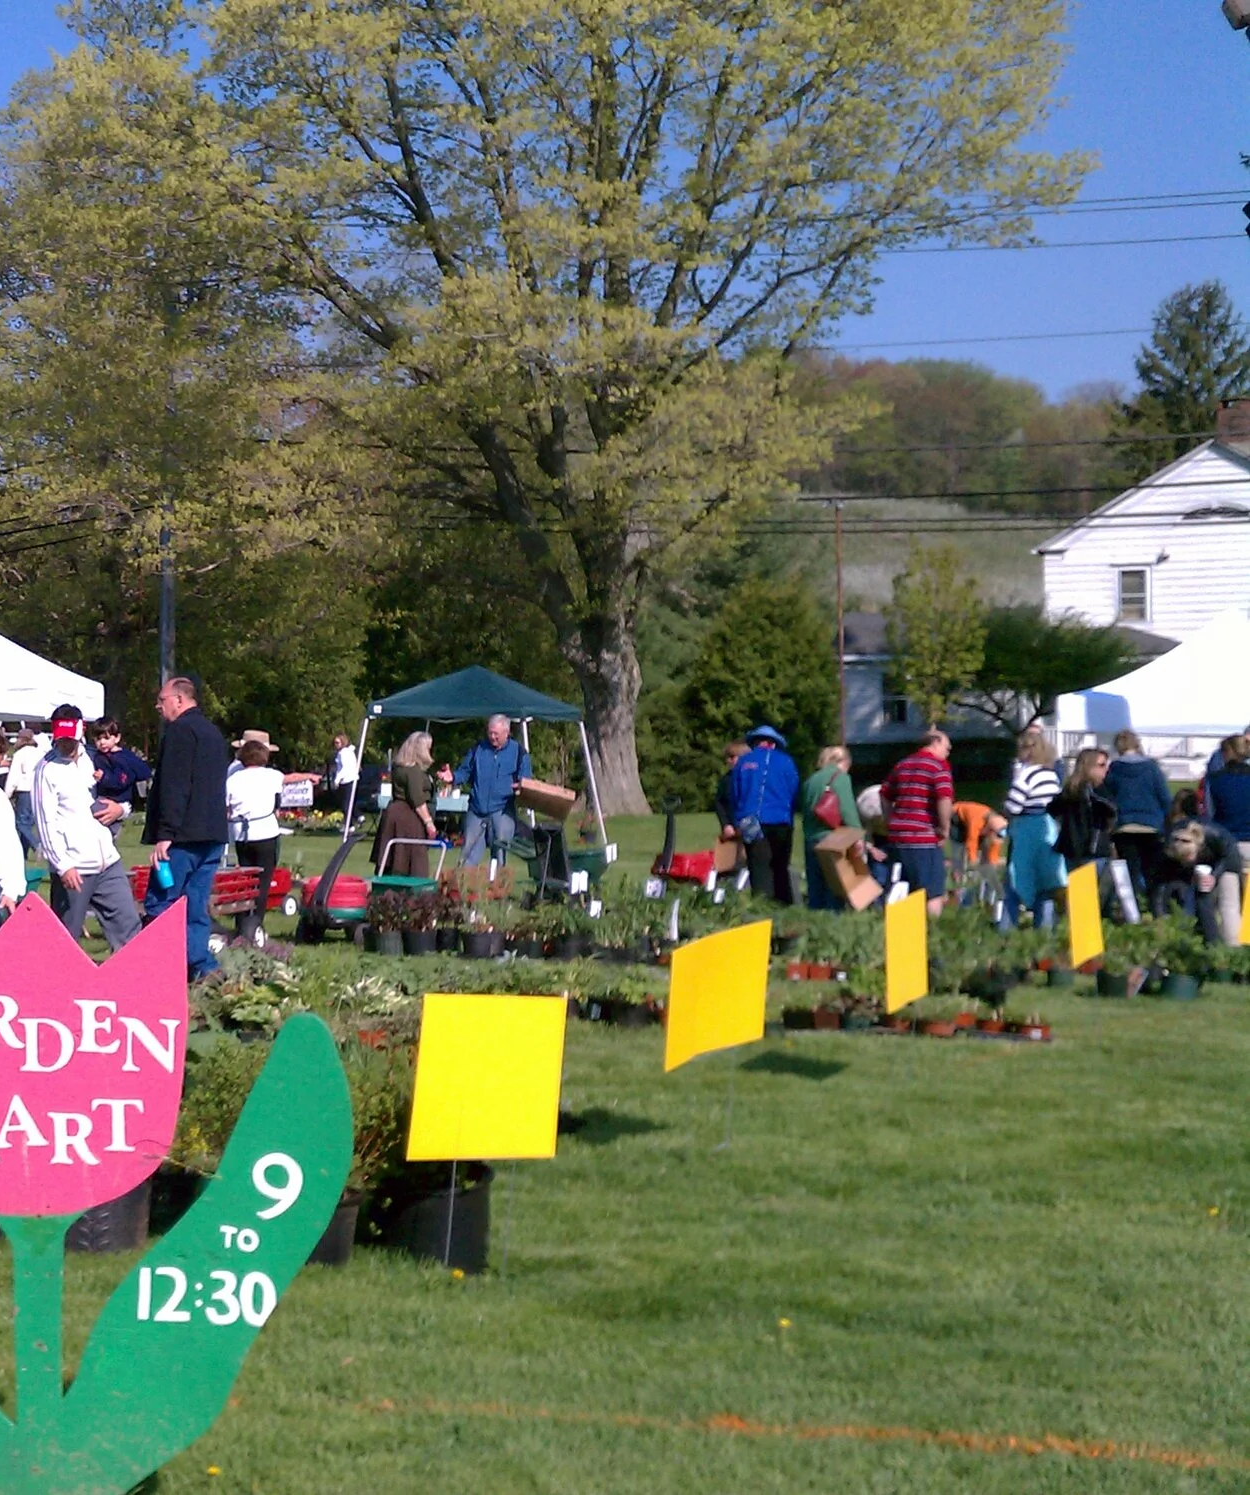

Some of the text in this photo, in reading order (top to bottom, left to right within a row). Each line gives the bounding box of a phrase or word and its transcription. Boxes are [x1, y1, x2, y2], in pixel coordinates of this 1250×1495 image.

[252, 1152, 304, 1219] 9
[220, 1225, 259, 1253] TO
[136, 1266, 278, 1327] 12:30
